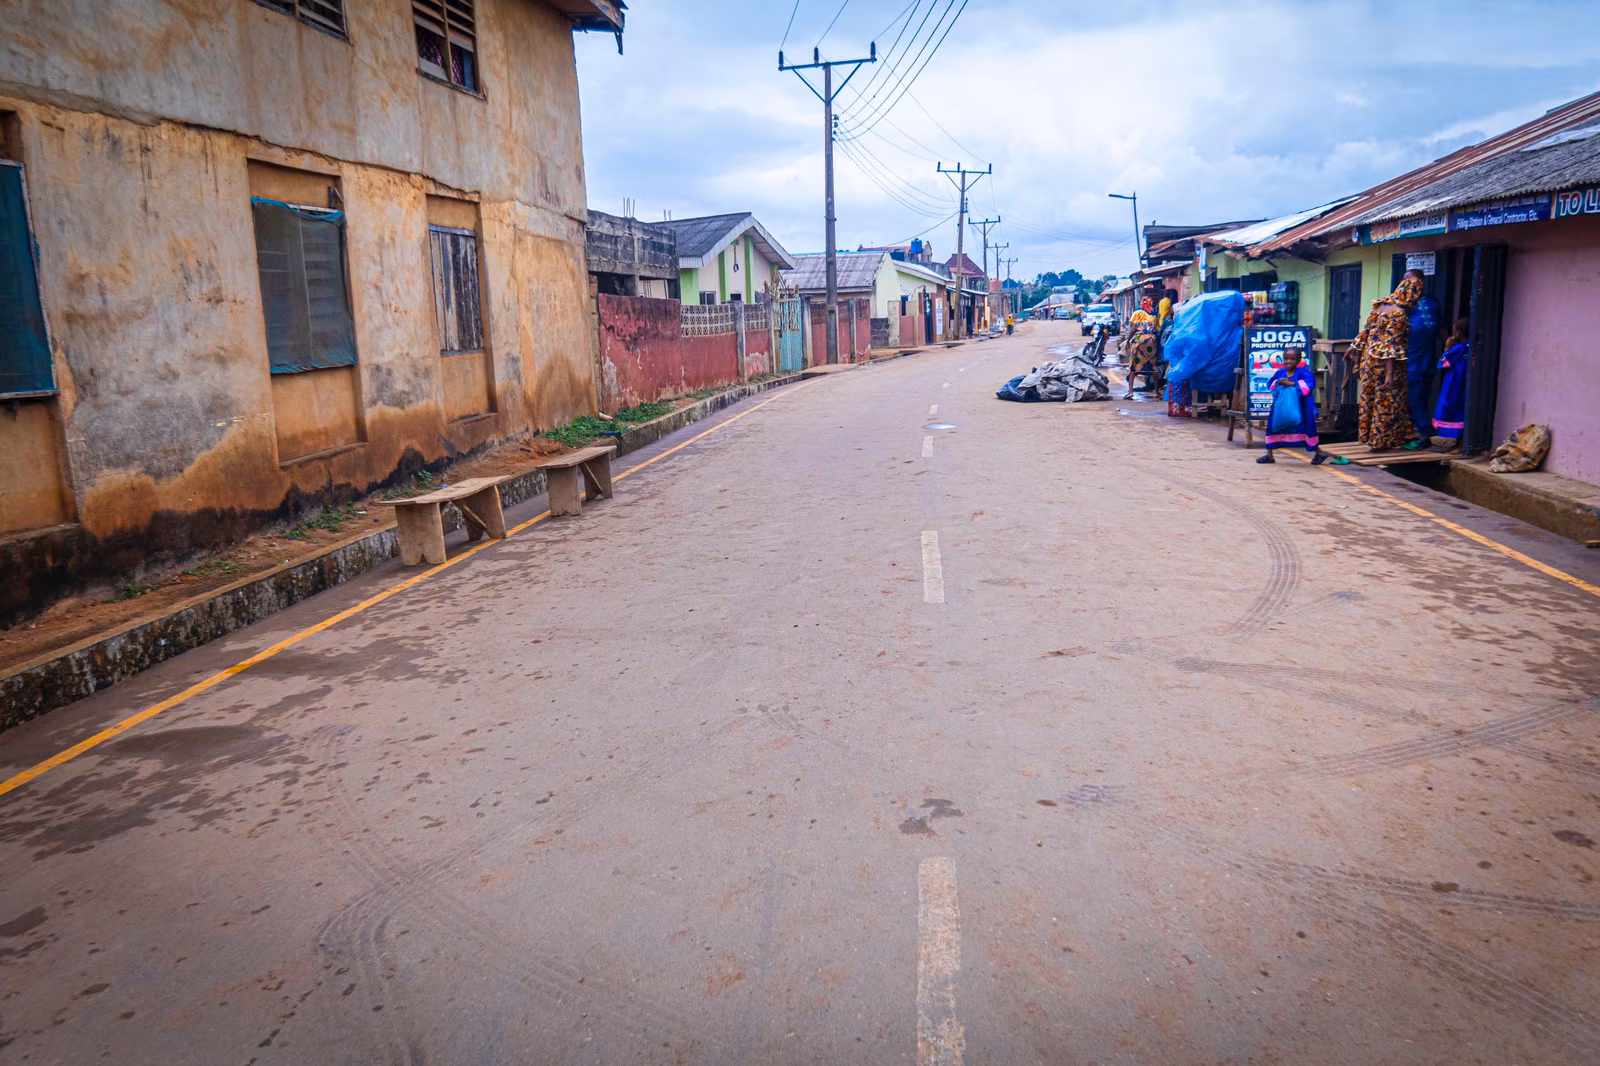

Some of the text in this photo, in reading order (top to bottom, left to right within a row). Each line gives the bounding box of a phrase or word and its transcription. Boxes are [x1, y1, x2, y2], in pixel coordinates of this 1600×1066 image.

[1559, 191, 1582, 216] TO
[1400, 216, 1427, 231] PROPERTY
[1427, 213, 1446, 226] AGENT
[1469, 216, 1483, 227] Station
[1487, 213, 1503, 225] General
[1251, 331, 1305, 342] JOGA
